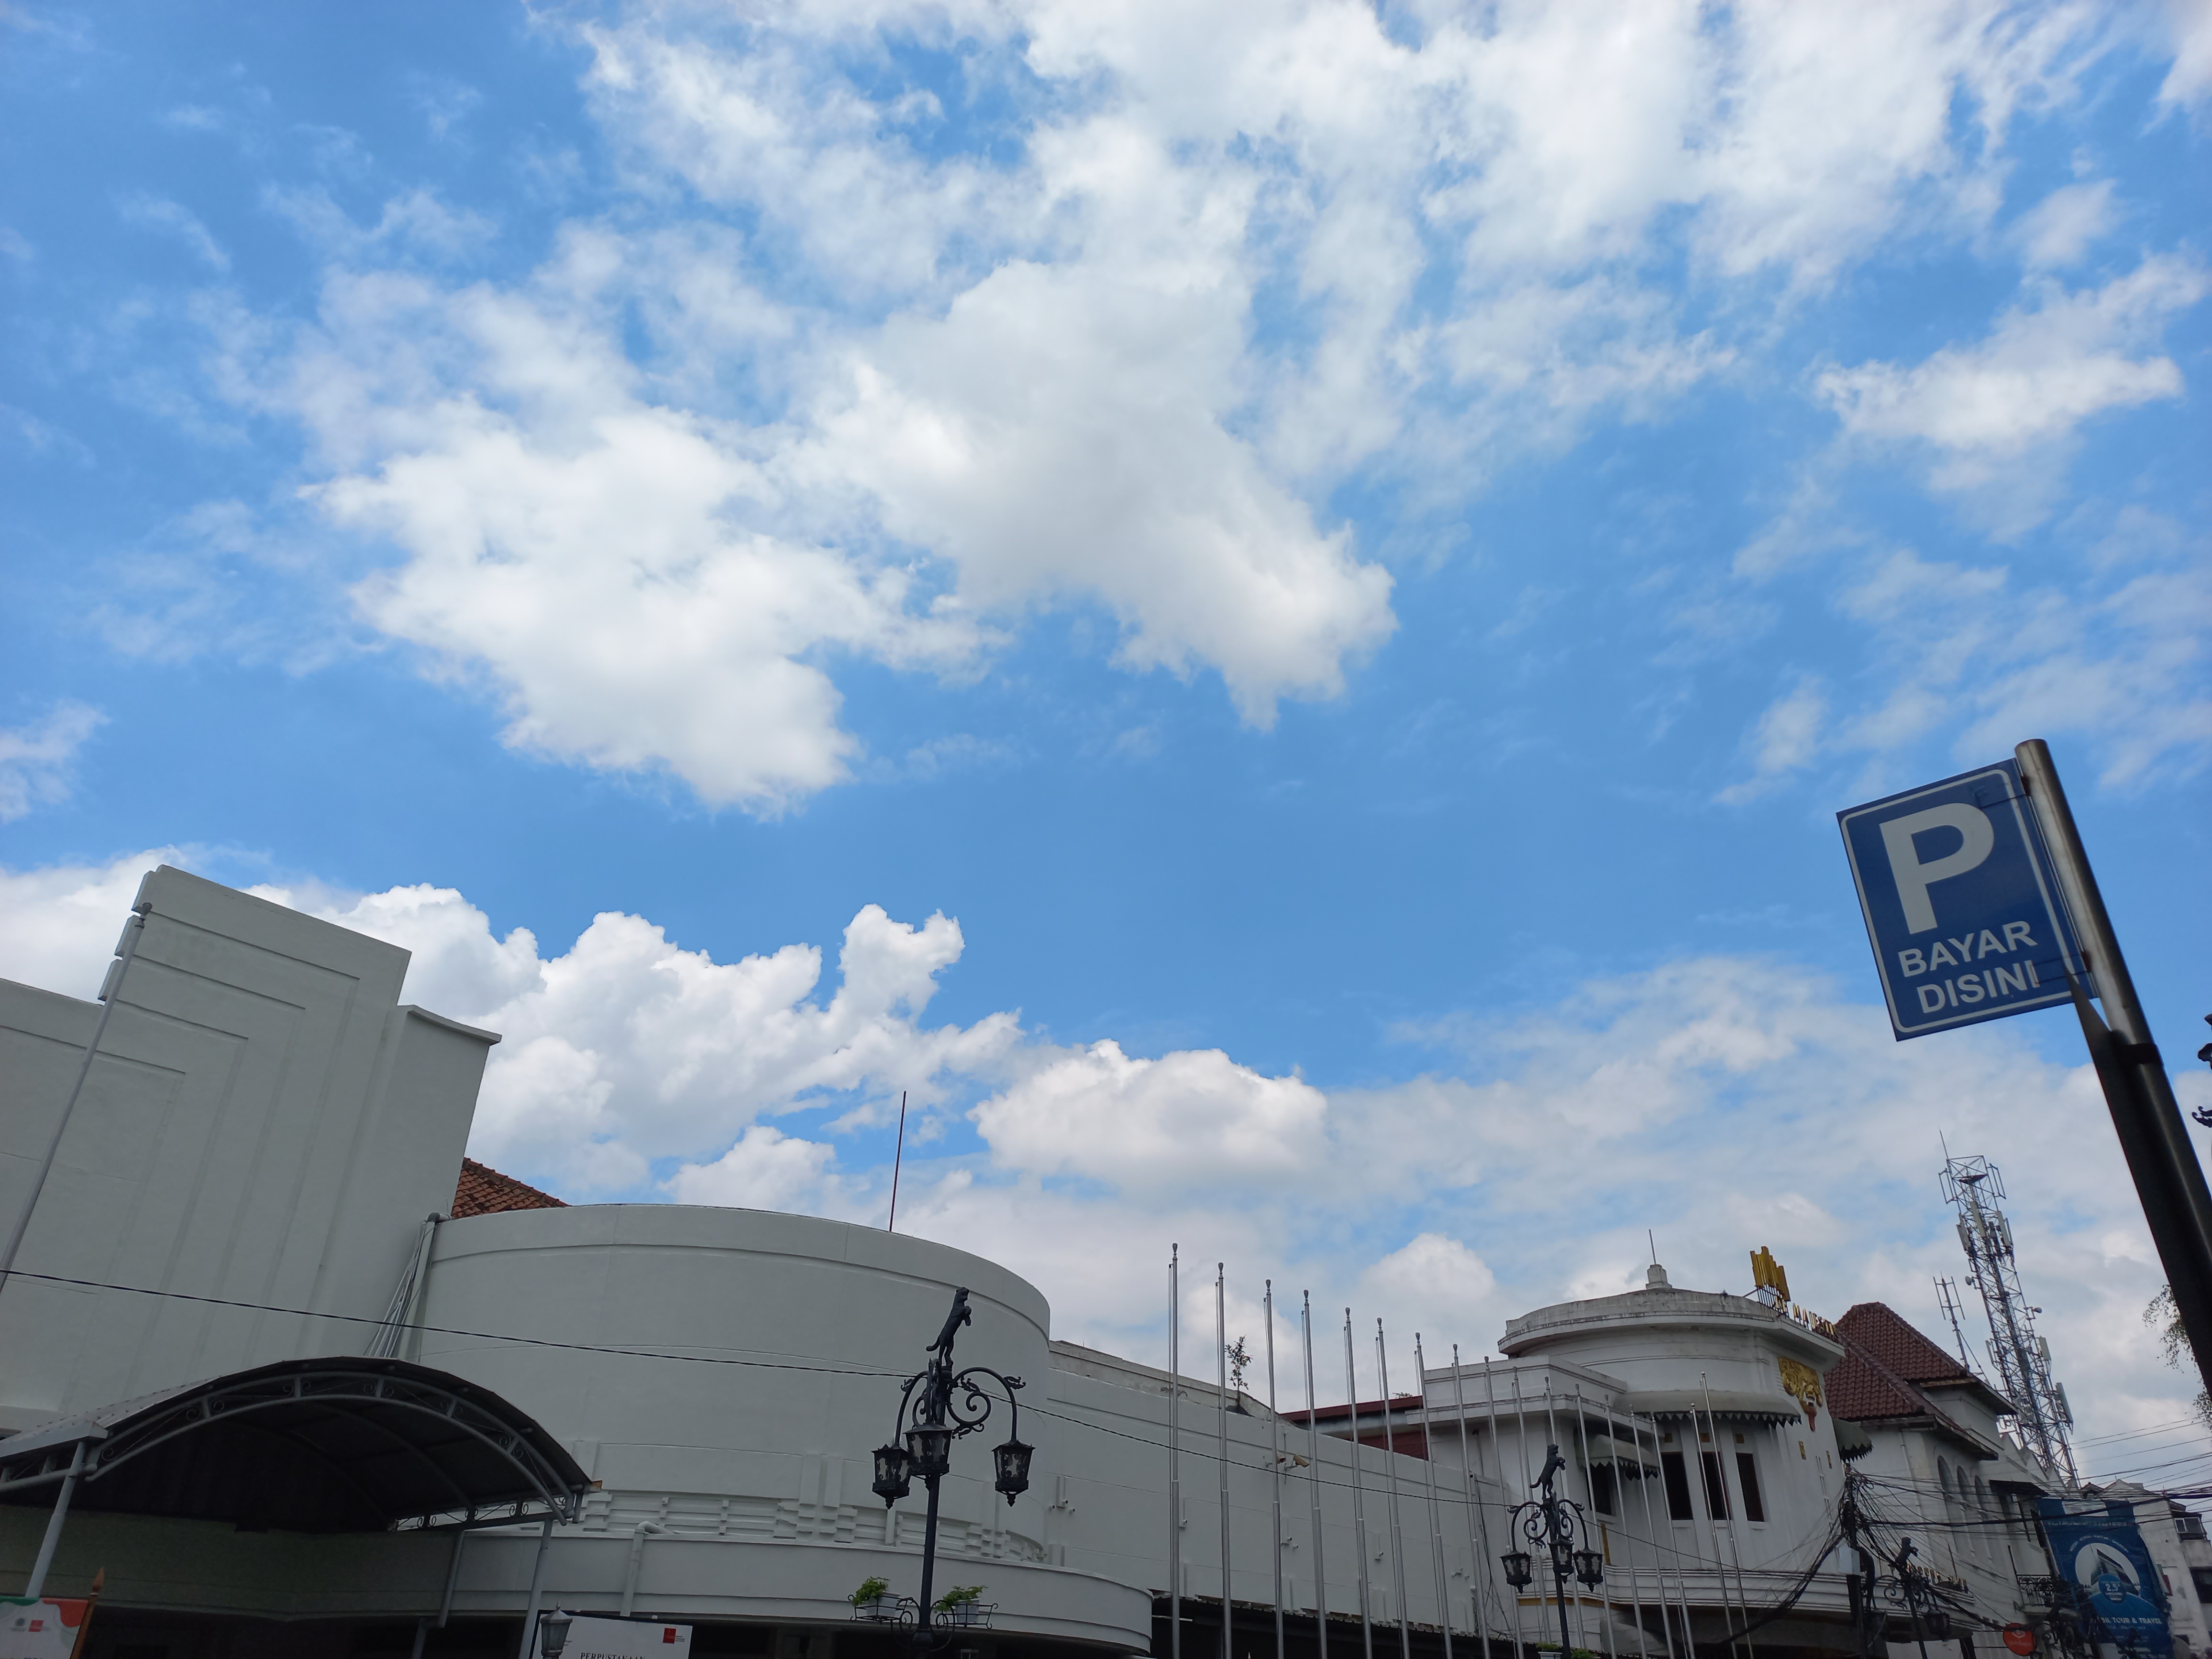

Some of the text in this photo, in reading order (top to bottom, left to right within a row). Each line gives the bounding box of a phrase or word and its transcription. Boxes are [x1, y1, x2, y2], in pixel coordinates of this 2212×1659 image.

[1880, 803, 1994, 934] P
[1898, 920, 2037, 977] BAYAR
[1916, 960, 2039, 1013] DISINI
